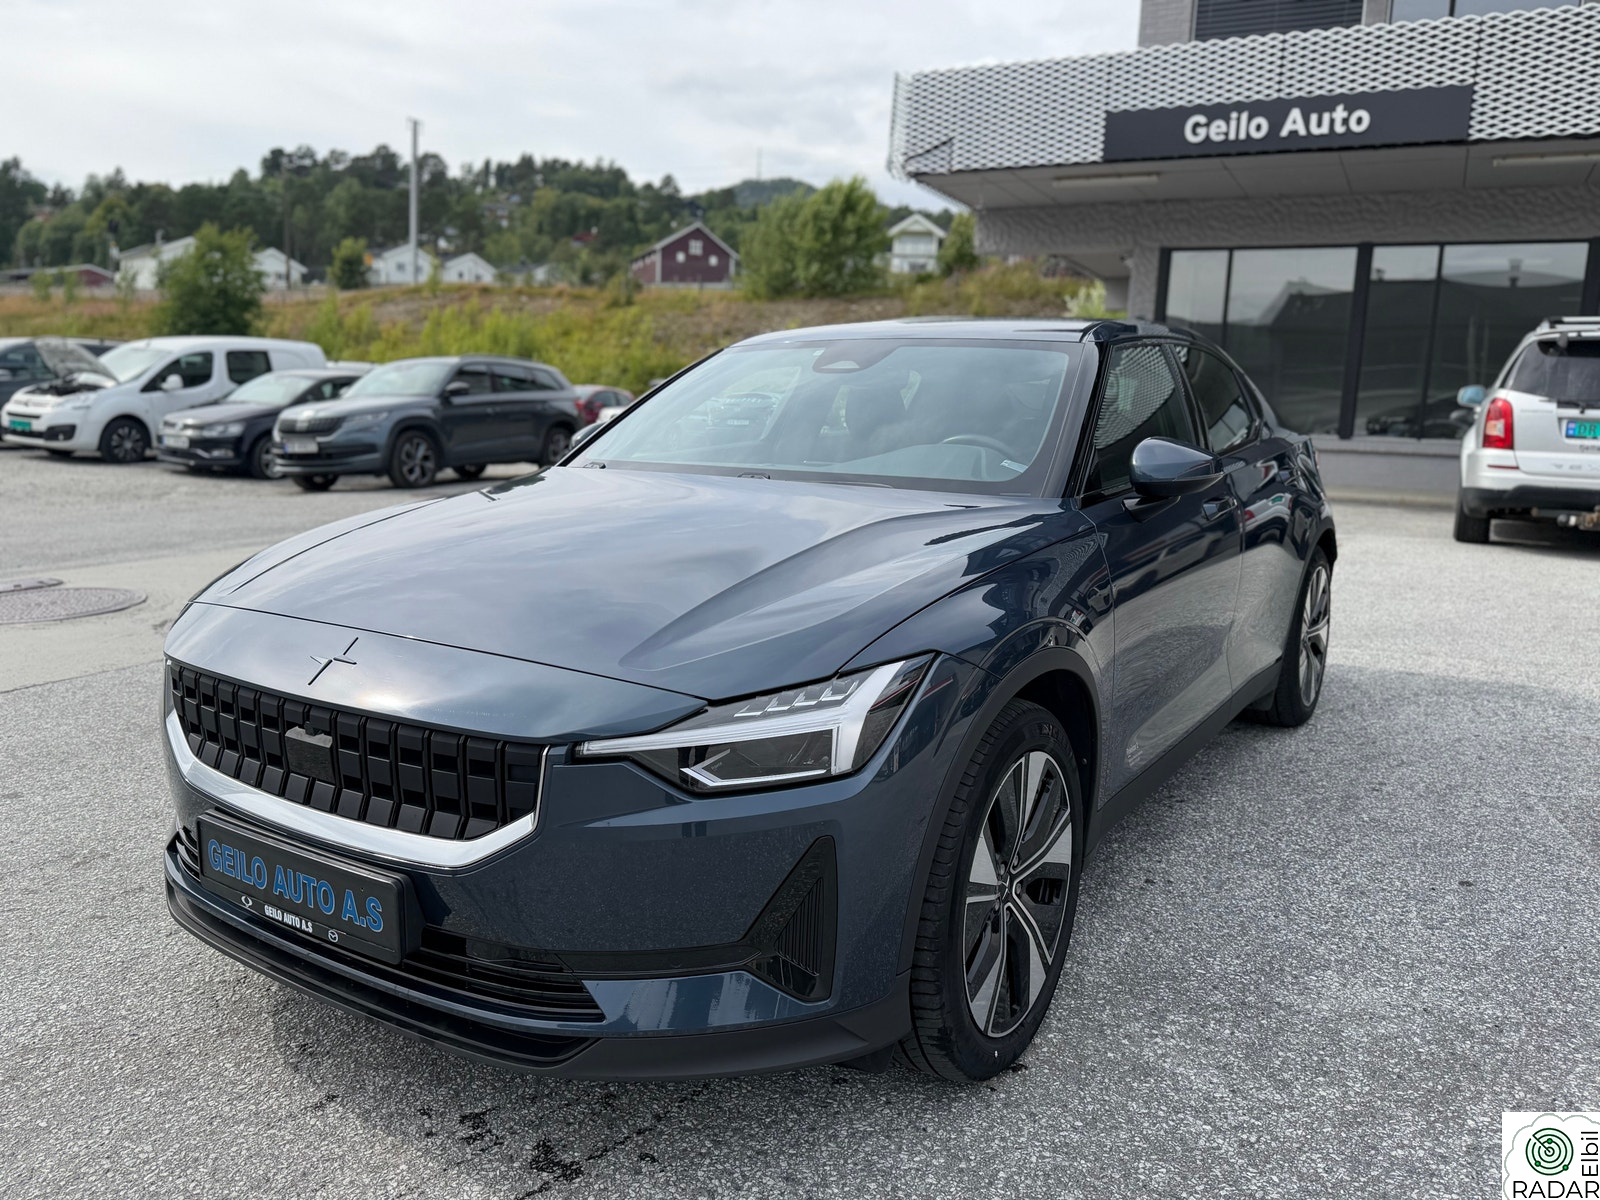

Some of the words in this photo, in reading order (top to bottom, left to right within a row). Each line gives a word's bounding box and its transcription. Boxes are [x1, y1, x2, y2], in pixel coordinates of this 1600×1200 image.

[1184, 111, 1269, 143] Geilo
[1279, 103, 1371, 137] Auto
[207, 838, 268, 890] GEILO
[272, 864, 336, 915] AUTO
[341, 889, 384, 933] A.S
[264, 904, 282, 921] GEILO
[283, 912, 301, 929] AUTO
[301, 920, 313, 933] A.S
